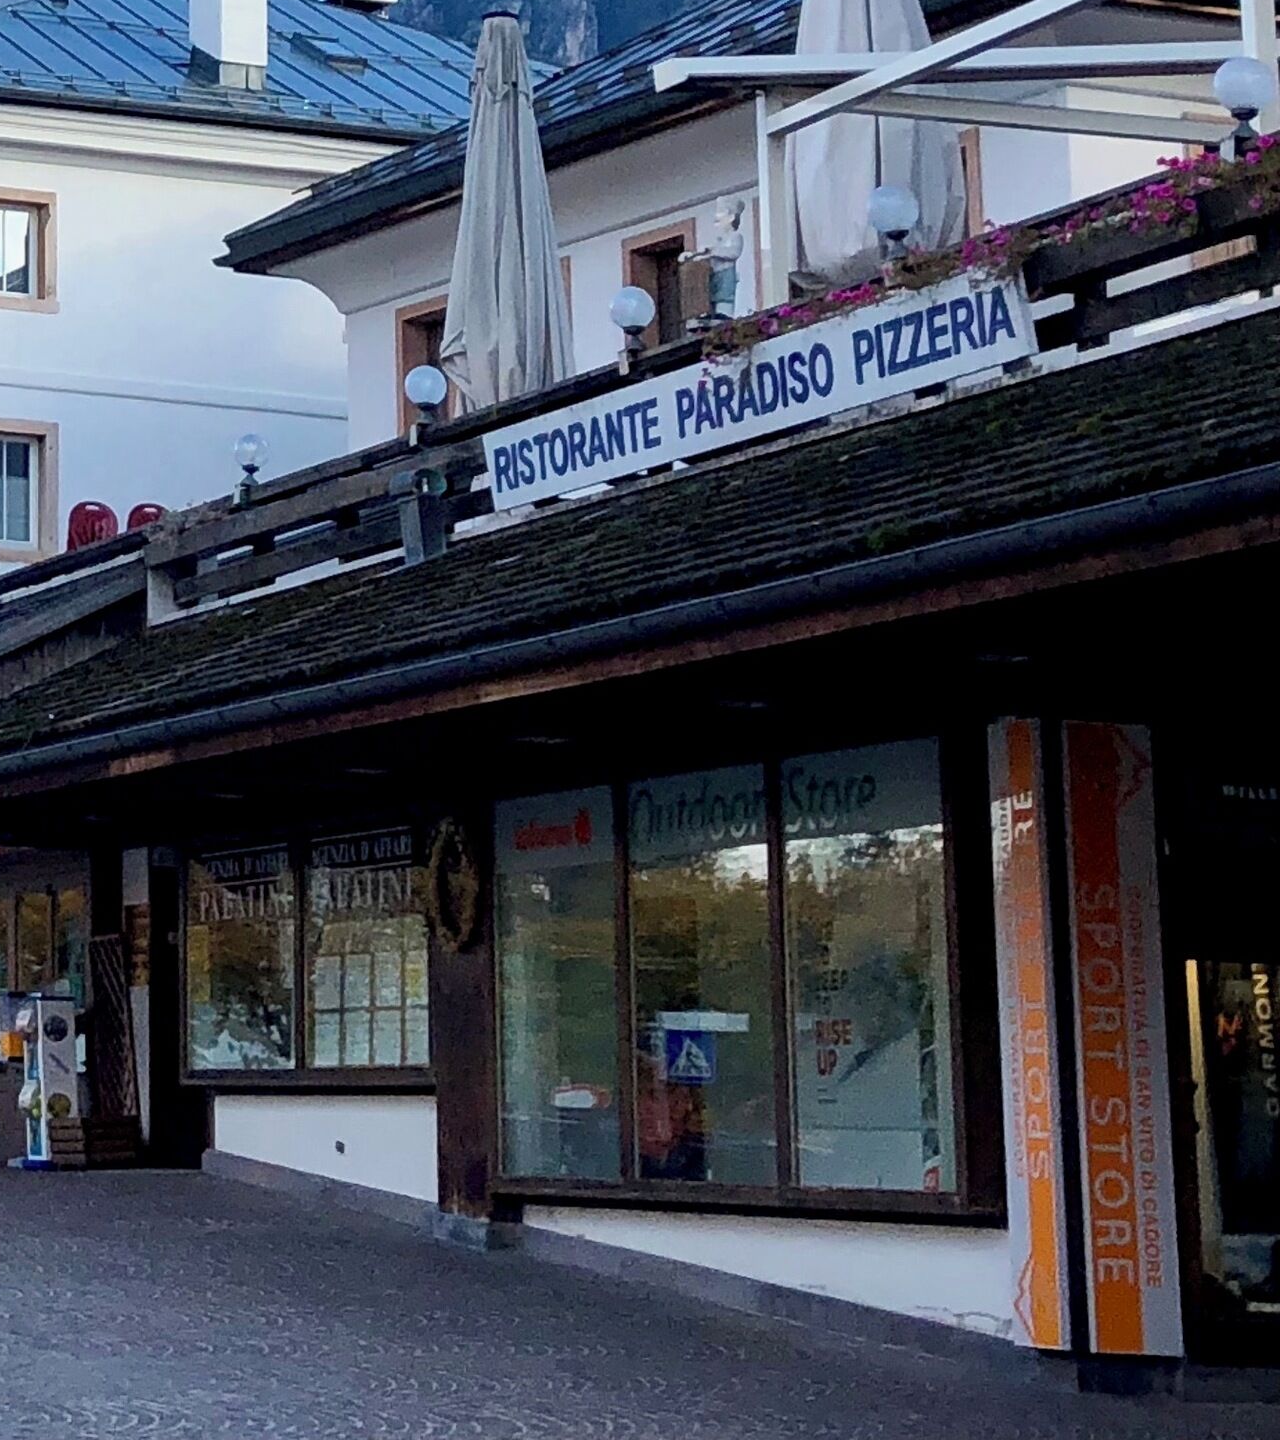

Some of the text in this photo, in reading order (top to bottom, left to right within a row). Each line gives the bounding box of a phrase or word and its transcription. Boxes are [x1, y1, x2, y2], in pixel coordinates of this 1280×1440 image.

[493, 286, 1016, 493] RISTORANTE PARADISO PIZZERIA
[786, 765, 876, 833] Store
[816, 1048, 838, 1077] UP
[1021, 994, 1052, 1181] SPORT
[1078, 881, 1135, 1287] SPORT STORE
[1136, 1067, 1151, 1110] SAN
[1139, 1116, 1156, 1162] VITO
[1141, 1170, 1157, 1191] DI
[1142, 1199, 1162, 1289] CADORE
